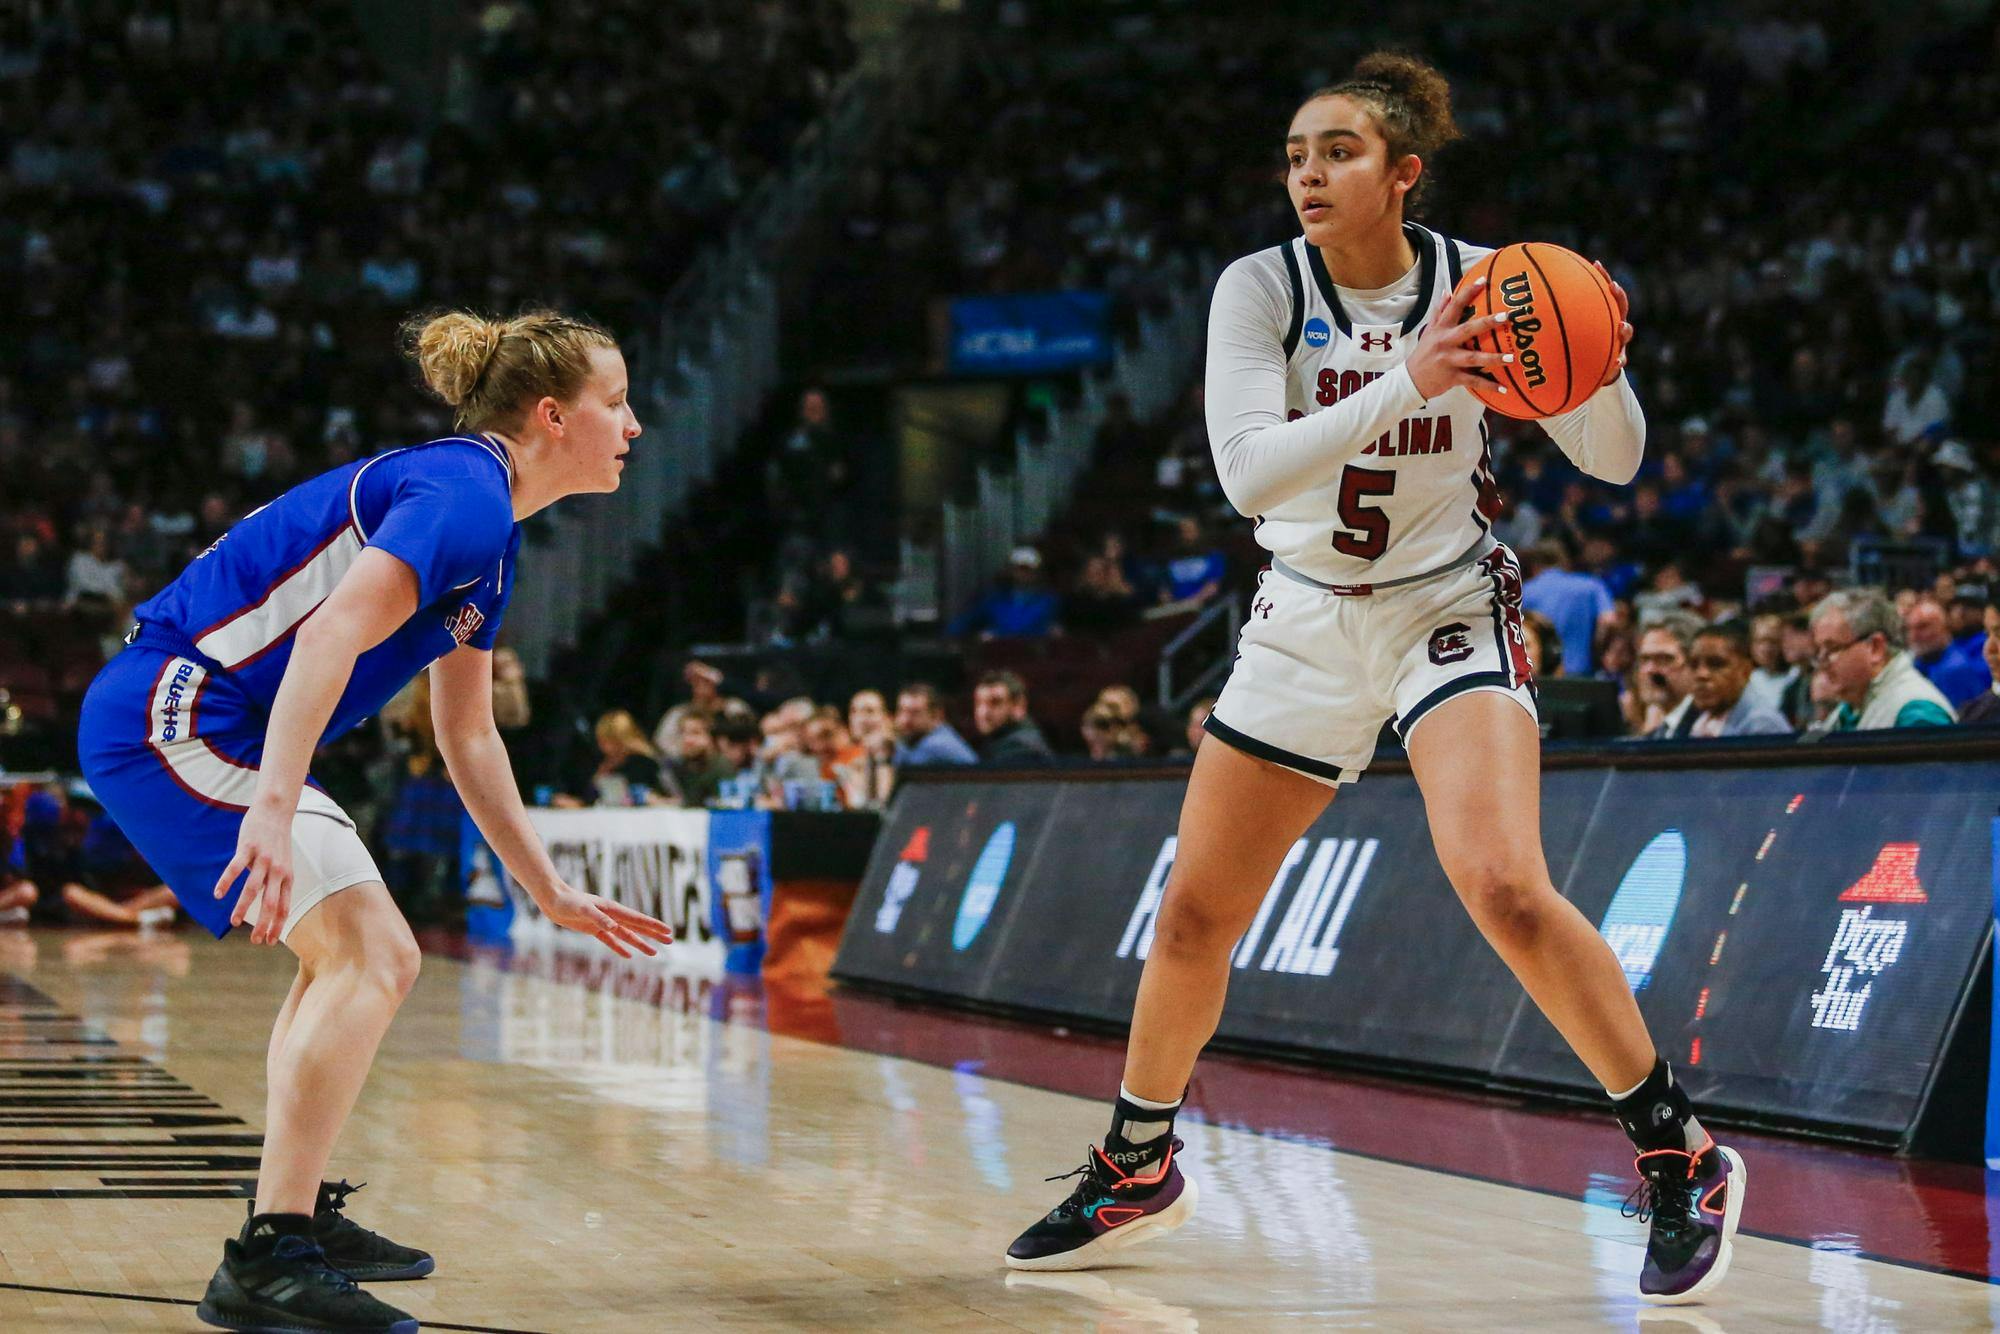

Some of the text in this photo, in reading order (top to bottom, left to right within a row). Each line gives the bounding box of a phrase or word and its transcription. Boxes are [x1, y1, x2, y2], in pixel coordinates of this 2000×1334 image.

[1500, 271, 1547, 389] Wilson
[1331, 464, 1396, 561] 5
[1260, 836, 1380, 976] ALL
[1820, 905, 1908, 976] Pizza
[1811, 966, 1873, 1031] Hut
